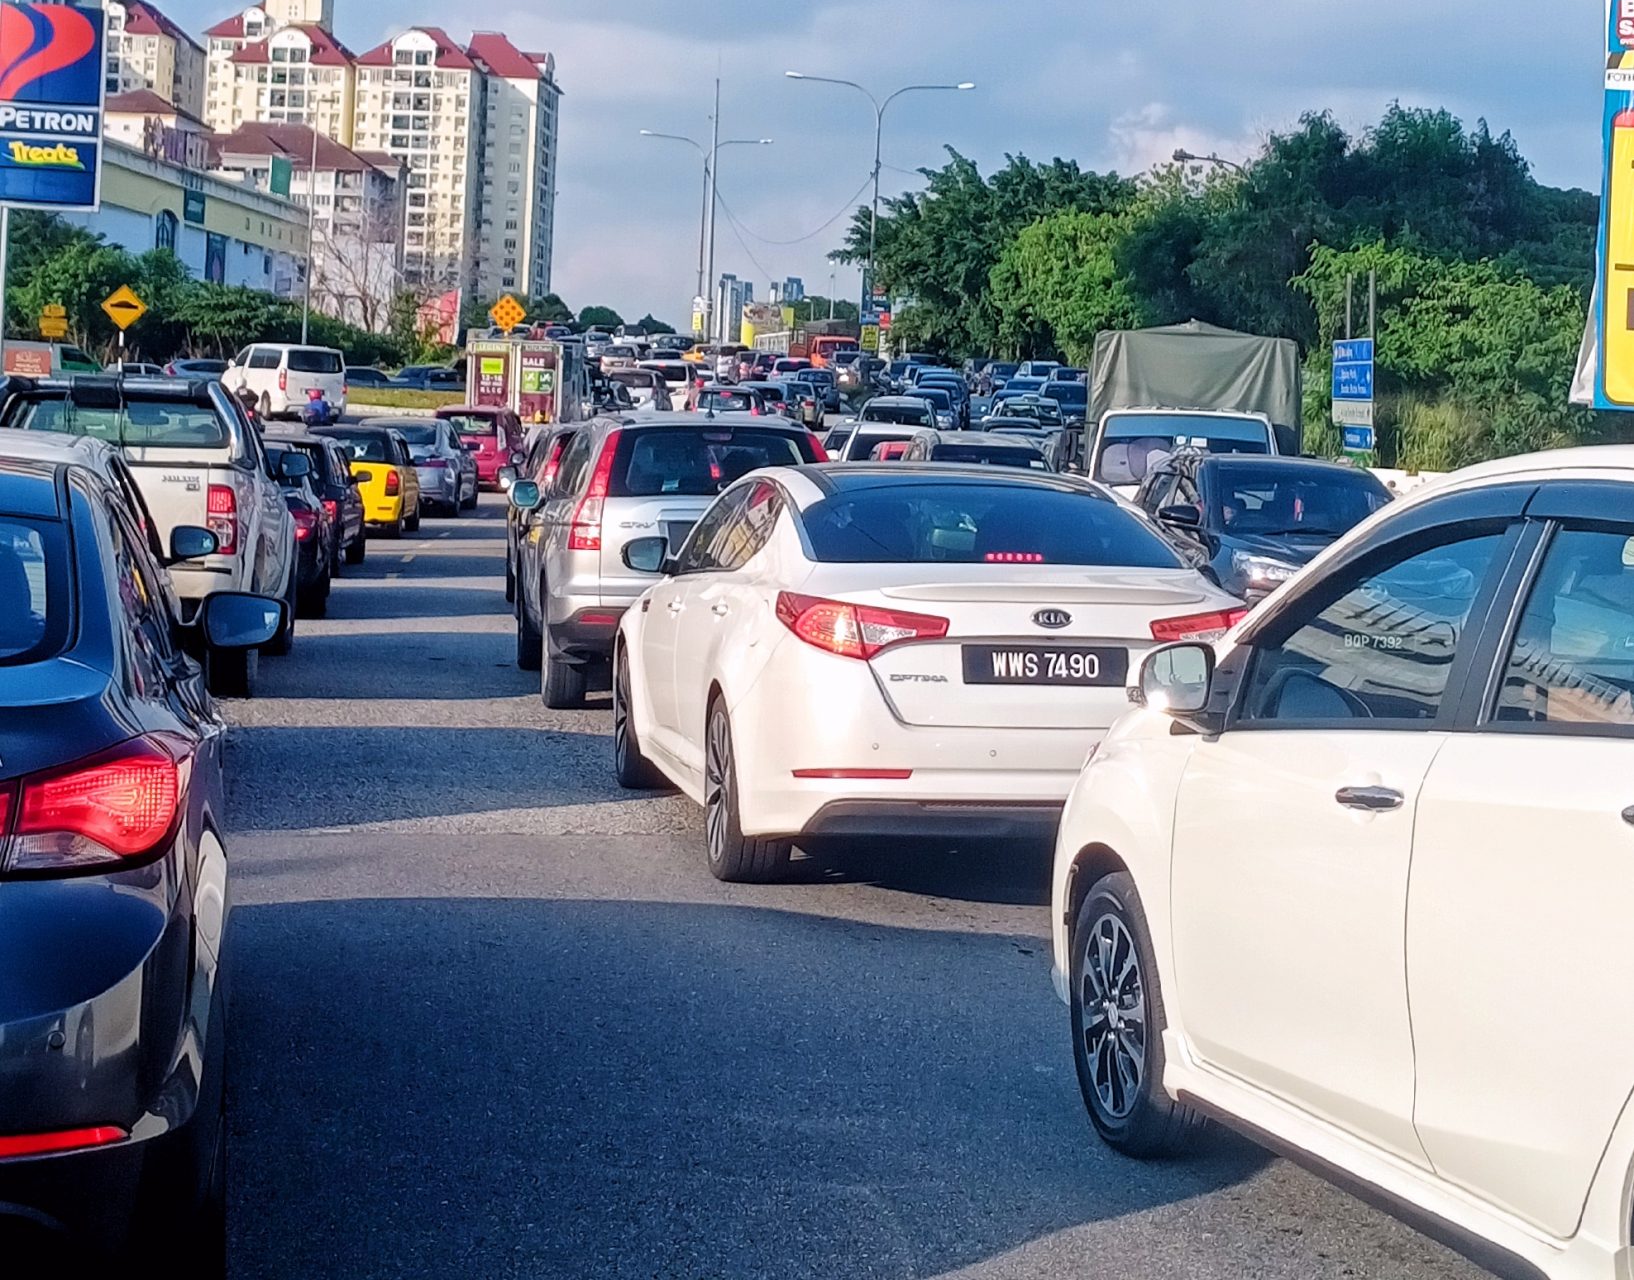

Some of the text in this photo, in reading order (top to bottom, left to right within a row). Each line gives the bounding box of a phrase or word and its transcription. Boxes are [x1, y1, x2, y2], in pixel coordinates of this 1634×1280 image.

[0, 106, 94, 132] PETRON
[8, 141, 79, 162] Treats
[522, 357, 545, 366] SALE
[1038, 612, 1067, 624] KIA
[1344, 634, 1402, 649] BQP 7392
[992, 652, 1099, 678] WWS 7490
